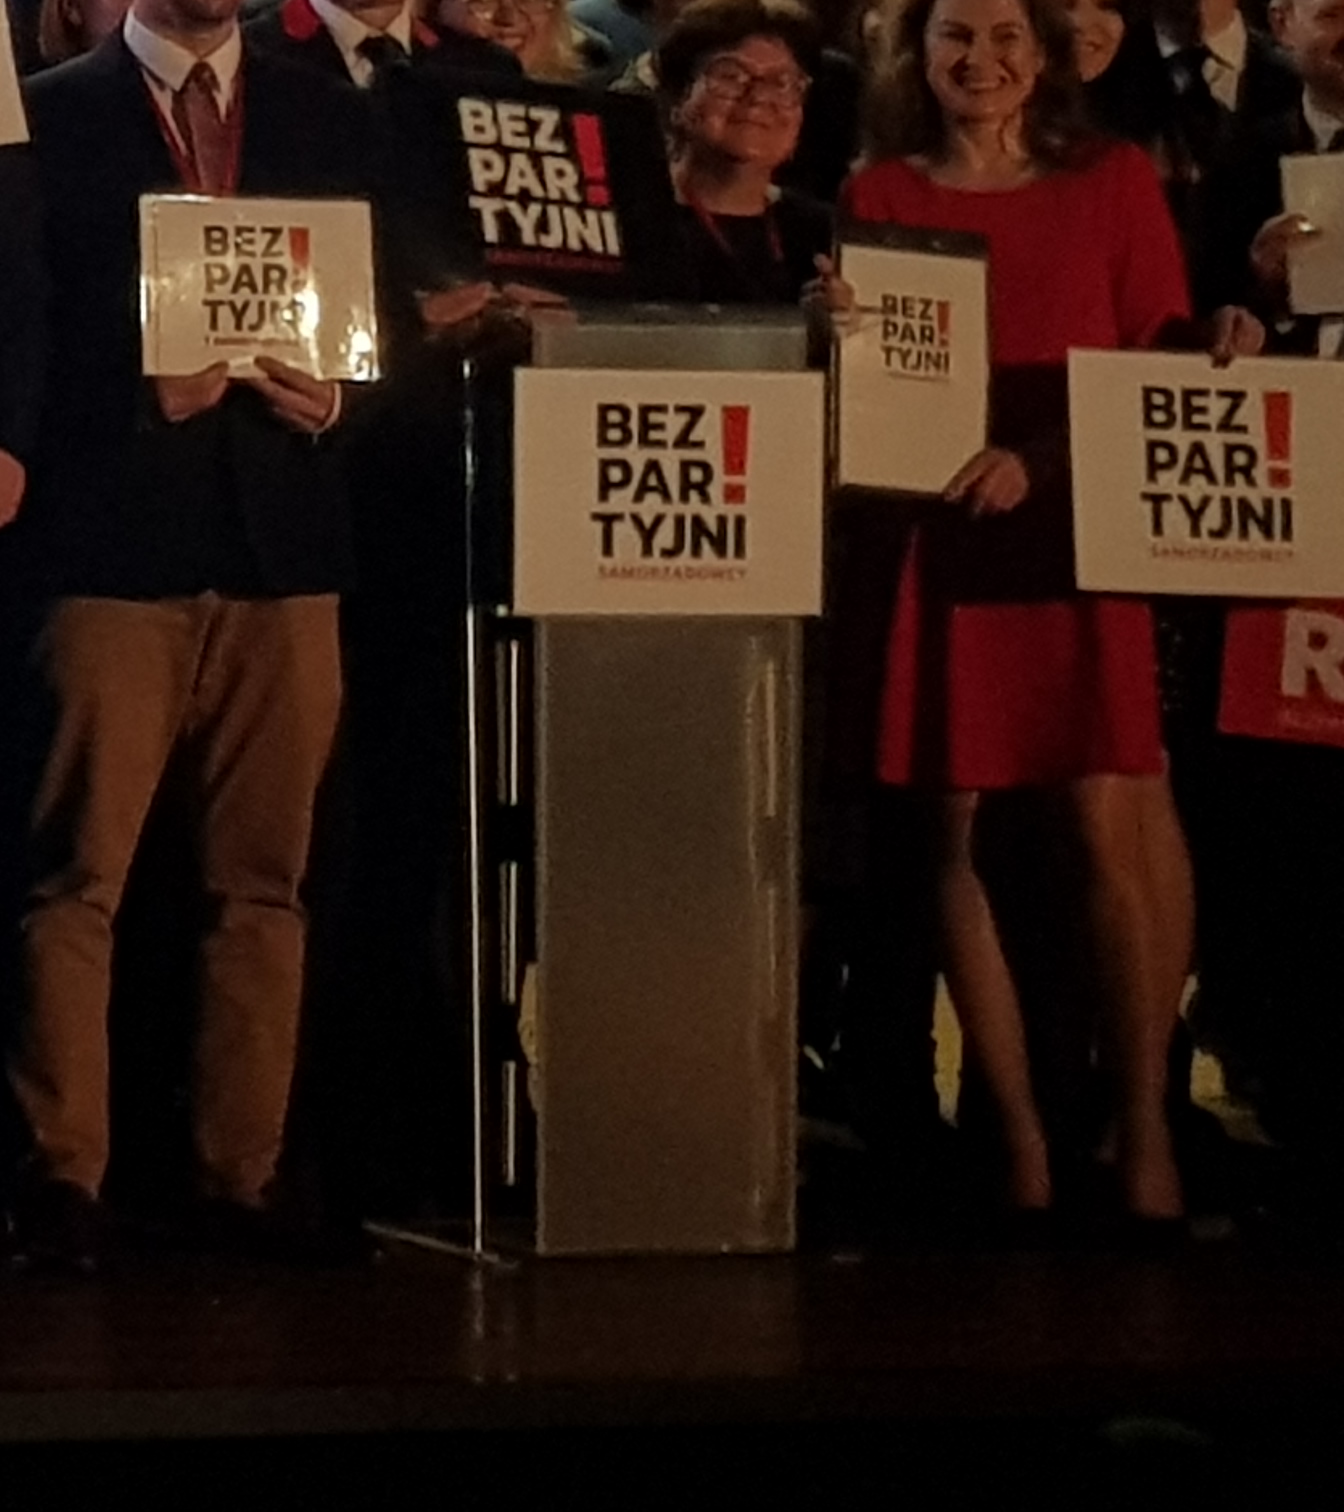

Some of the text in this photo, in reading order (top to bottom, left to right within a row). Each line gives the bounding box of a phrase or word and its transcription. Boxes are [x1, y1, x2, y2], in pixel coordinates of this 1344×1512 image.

[457, 96, 565, 149] BEZ
[467, 147, 582, 203] PAR
[203, 225, 285, 258] BEZ
[467, 195, 620, 257] TYJNI
[204, 262, 288, 295] PAR
[881, 293, 934, 321] BEZ
[882, 317, 935, 345] PAR
[880, 343, 950, 375] TYJNI
[596, 403, 707, 450] BEZ
[1141, 386, 1248, 434] BEZ
[597, 458, 714, 506] PAR
[1144, 440, 1259, 488] PAR
[590, 513, 748, 560] TYJNI
[1140, 492, 1294, 543] TYJNI
